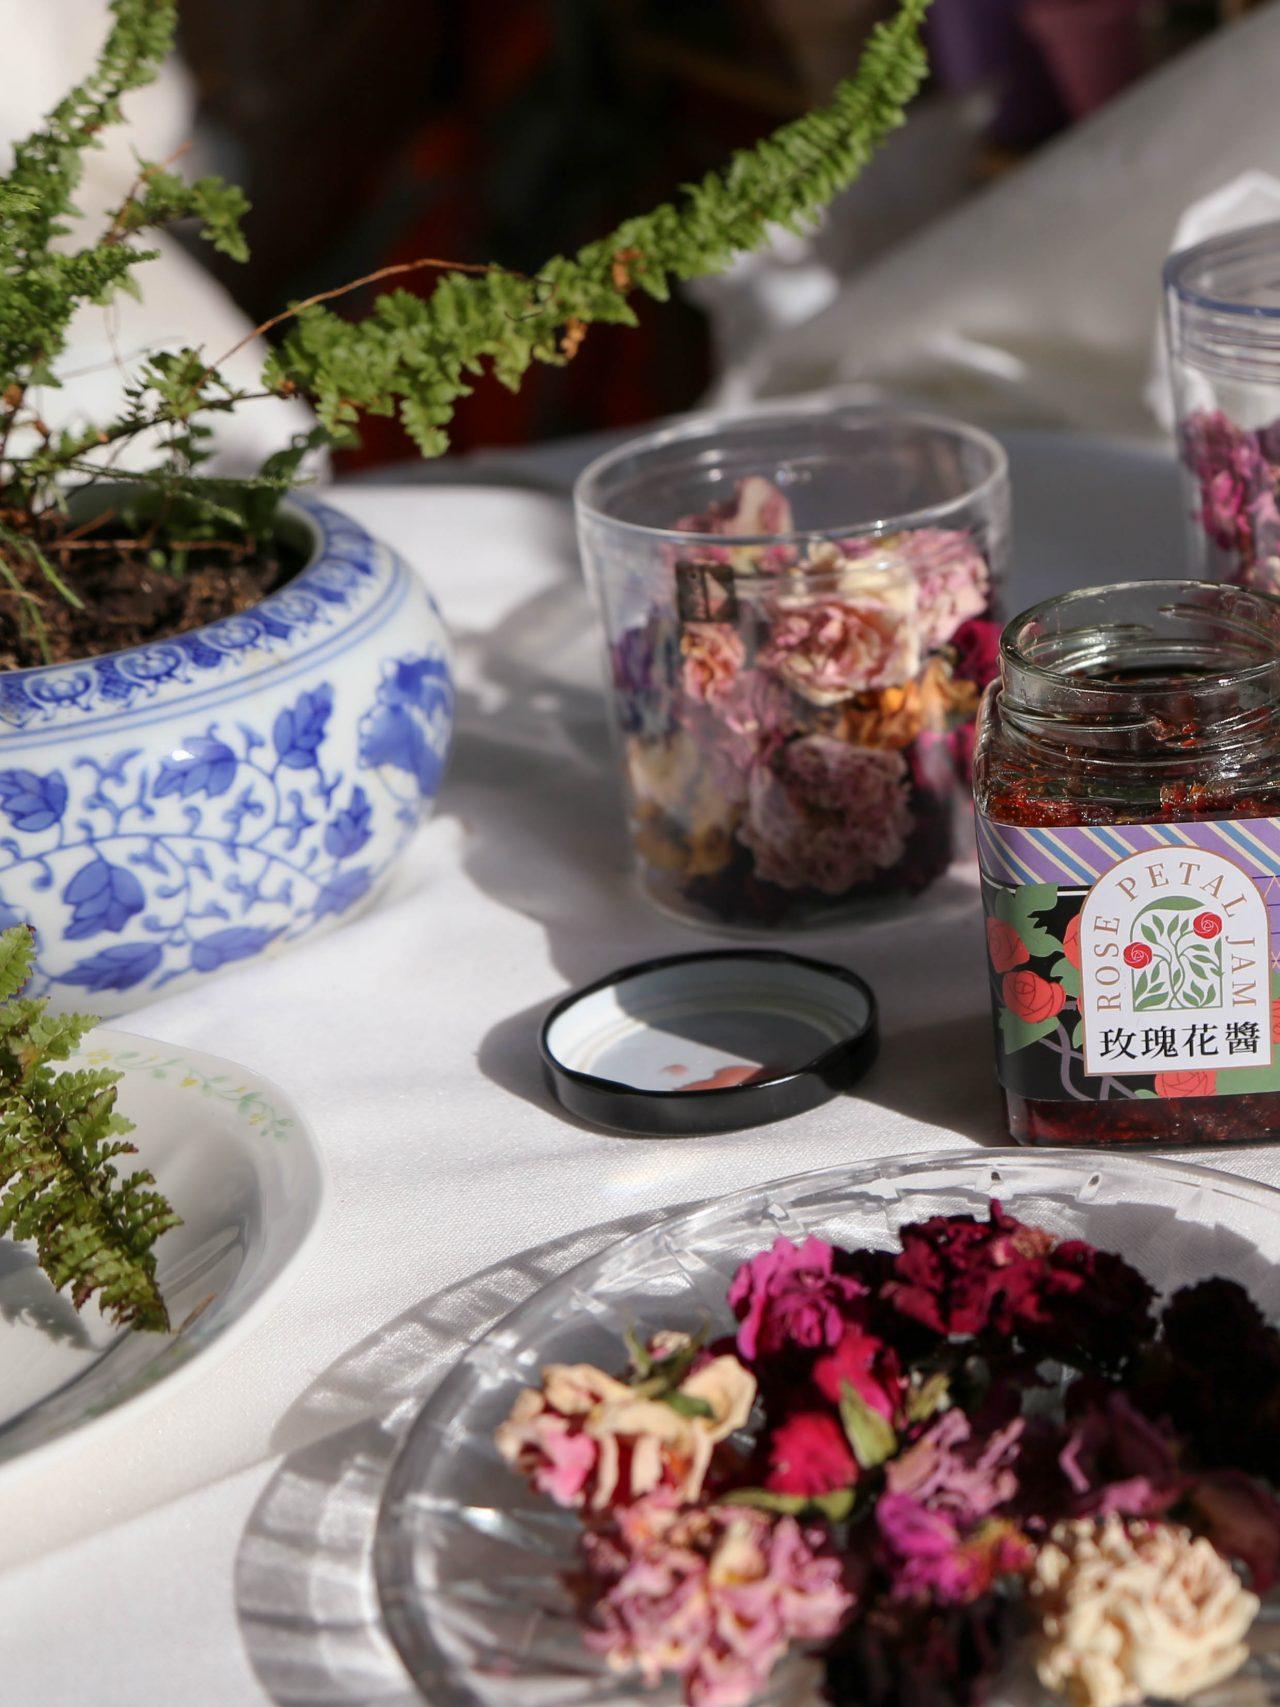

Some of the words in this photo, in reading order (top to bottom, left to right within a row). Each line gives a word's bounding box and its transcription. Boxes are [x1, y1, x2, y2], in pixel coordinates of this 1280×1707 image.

[1094, 915, 1121, 1012] ROSE
[1115, 862, 1247, 918] PETAL
[1226, 935, 1257, 1007] JAM
[1099, 1021, 1261, 1061] 玫瑰花醬
